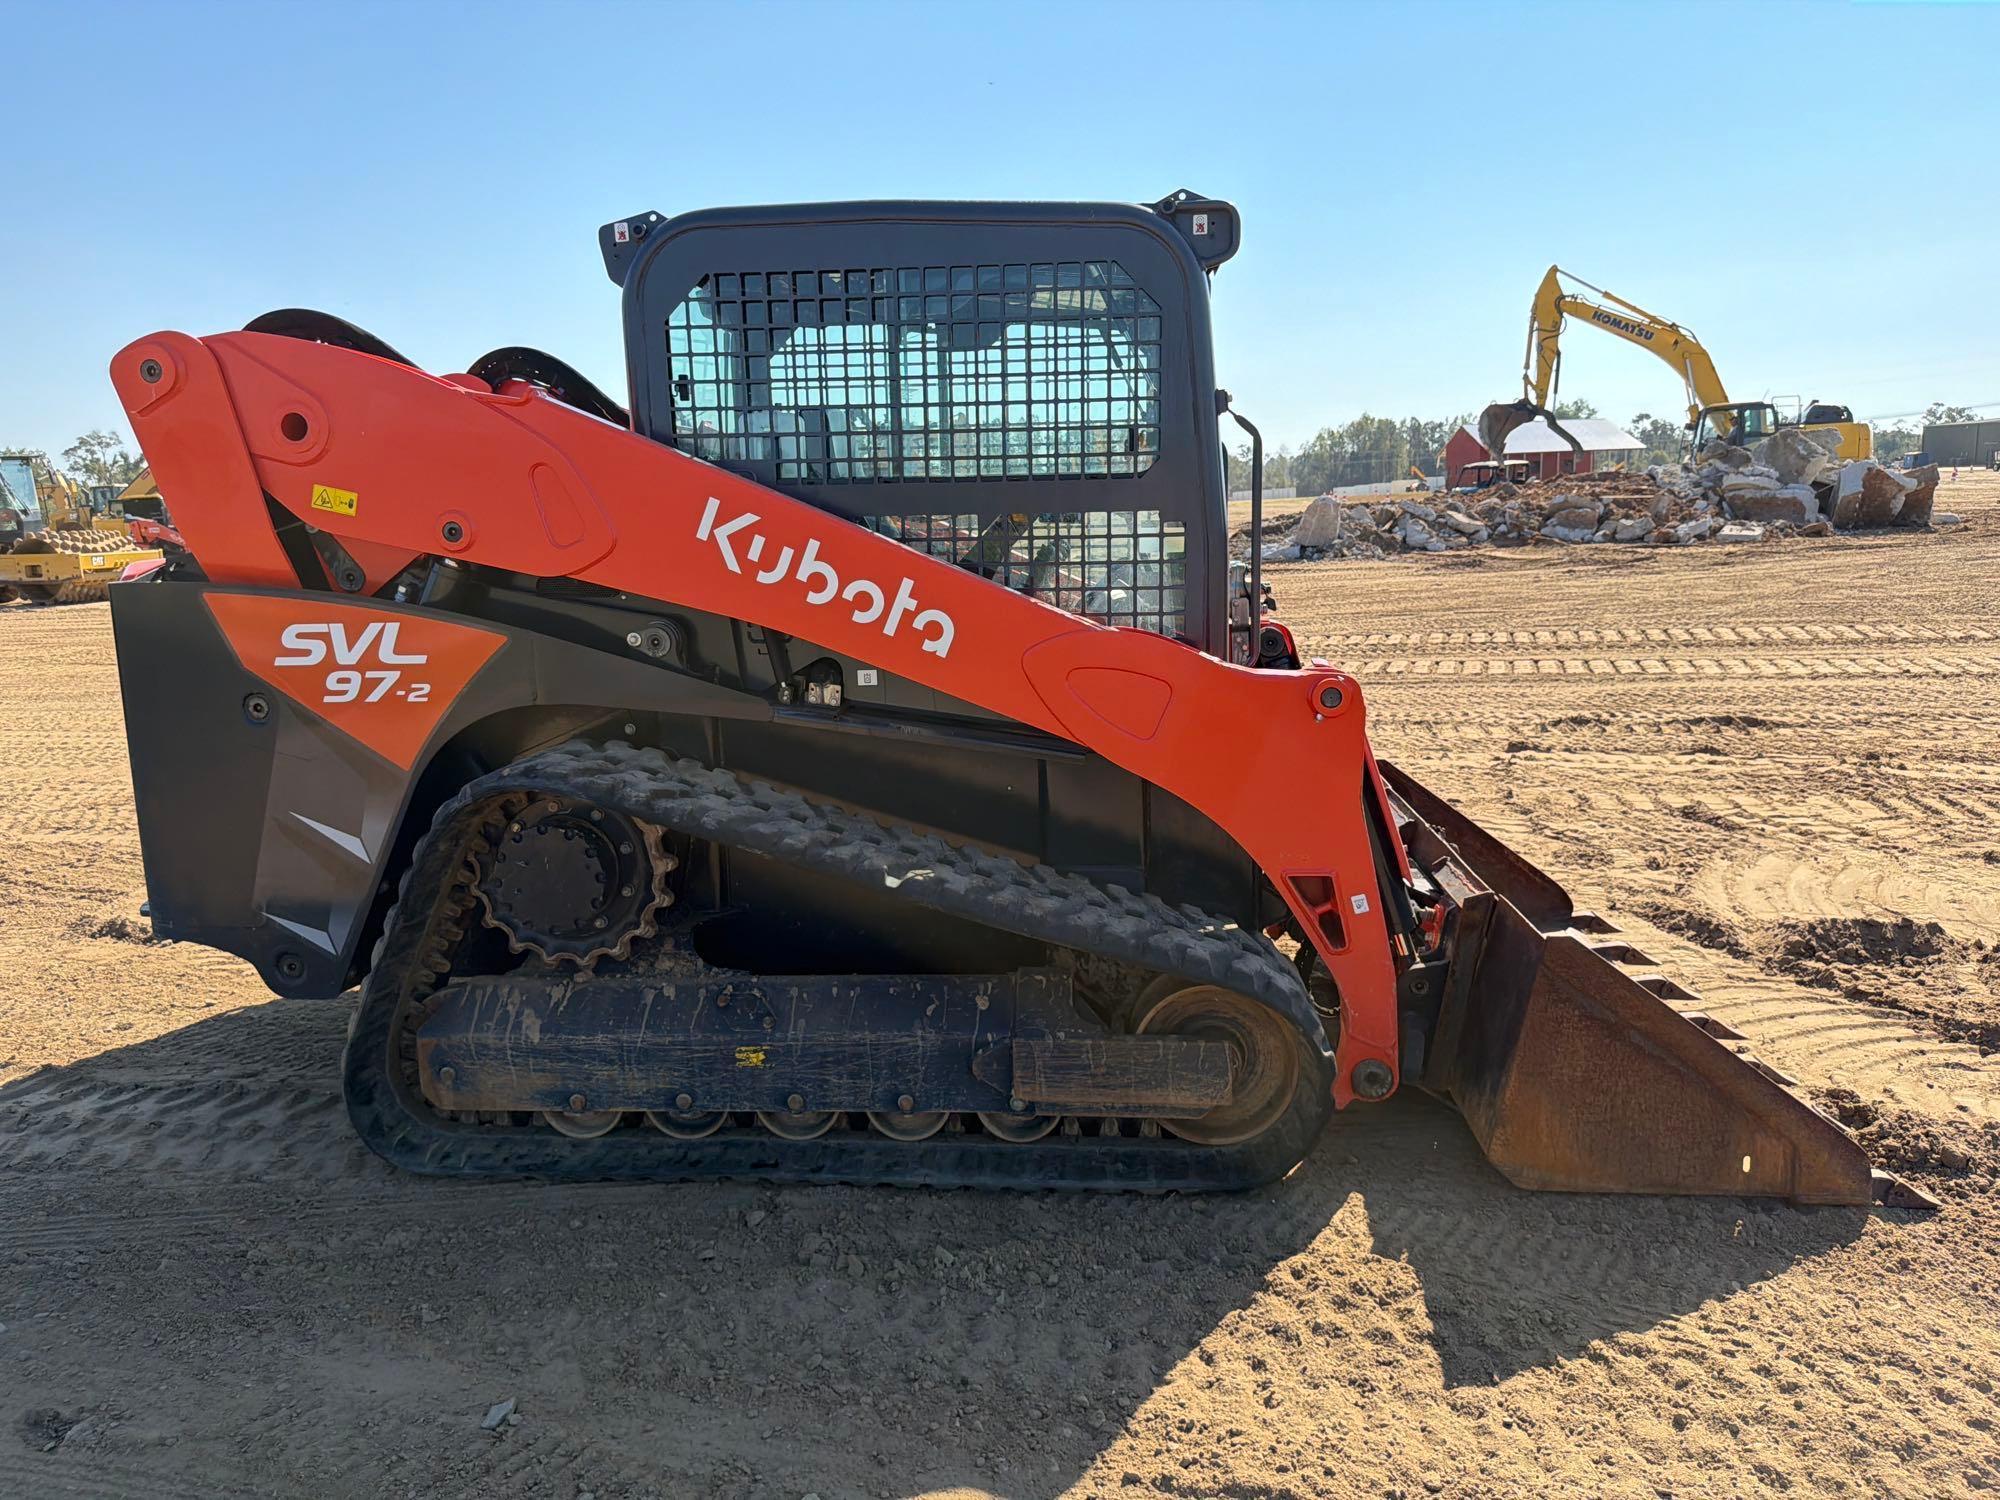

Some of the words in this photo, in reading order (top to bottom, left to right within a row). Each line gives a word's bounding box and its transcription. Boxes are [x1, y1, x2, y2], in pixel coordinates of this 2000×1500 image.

[1592, 310, 1655, 340] KOMATSU
[695, 496, 955, 659] Kubota
[274, 621, 428, 666] SVL
[322, 670, 432, 703] 97-2
